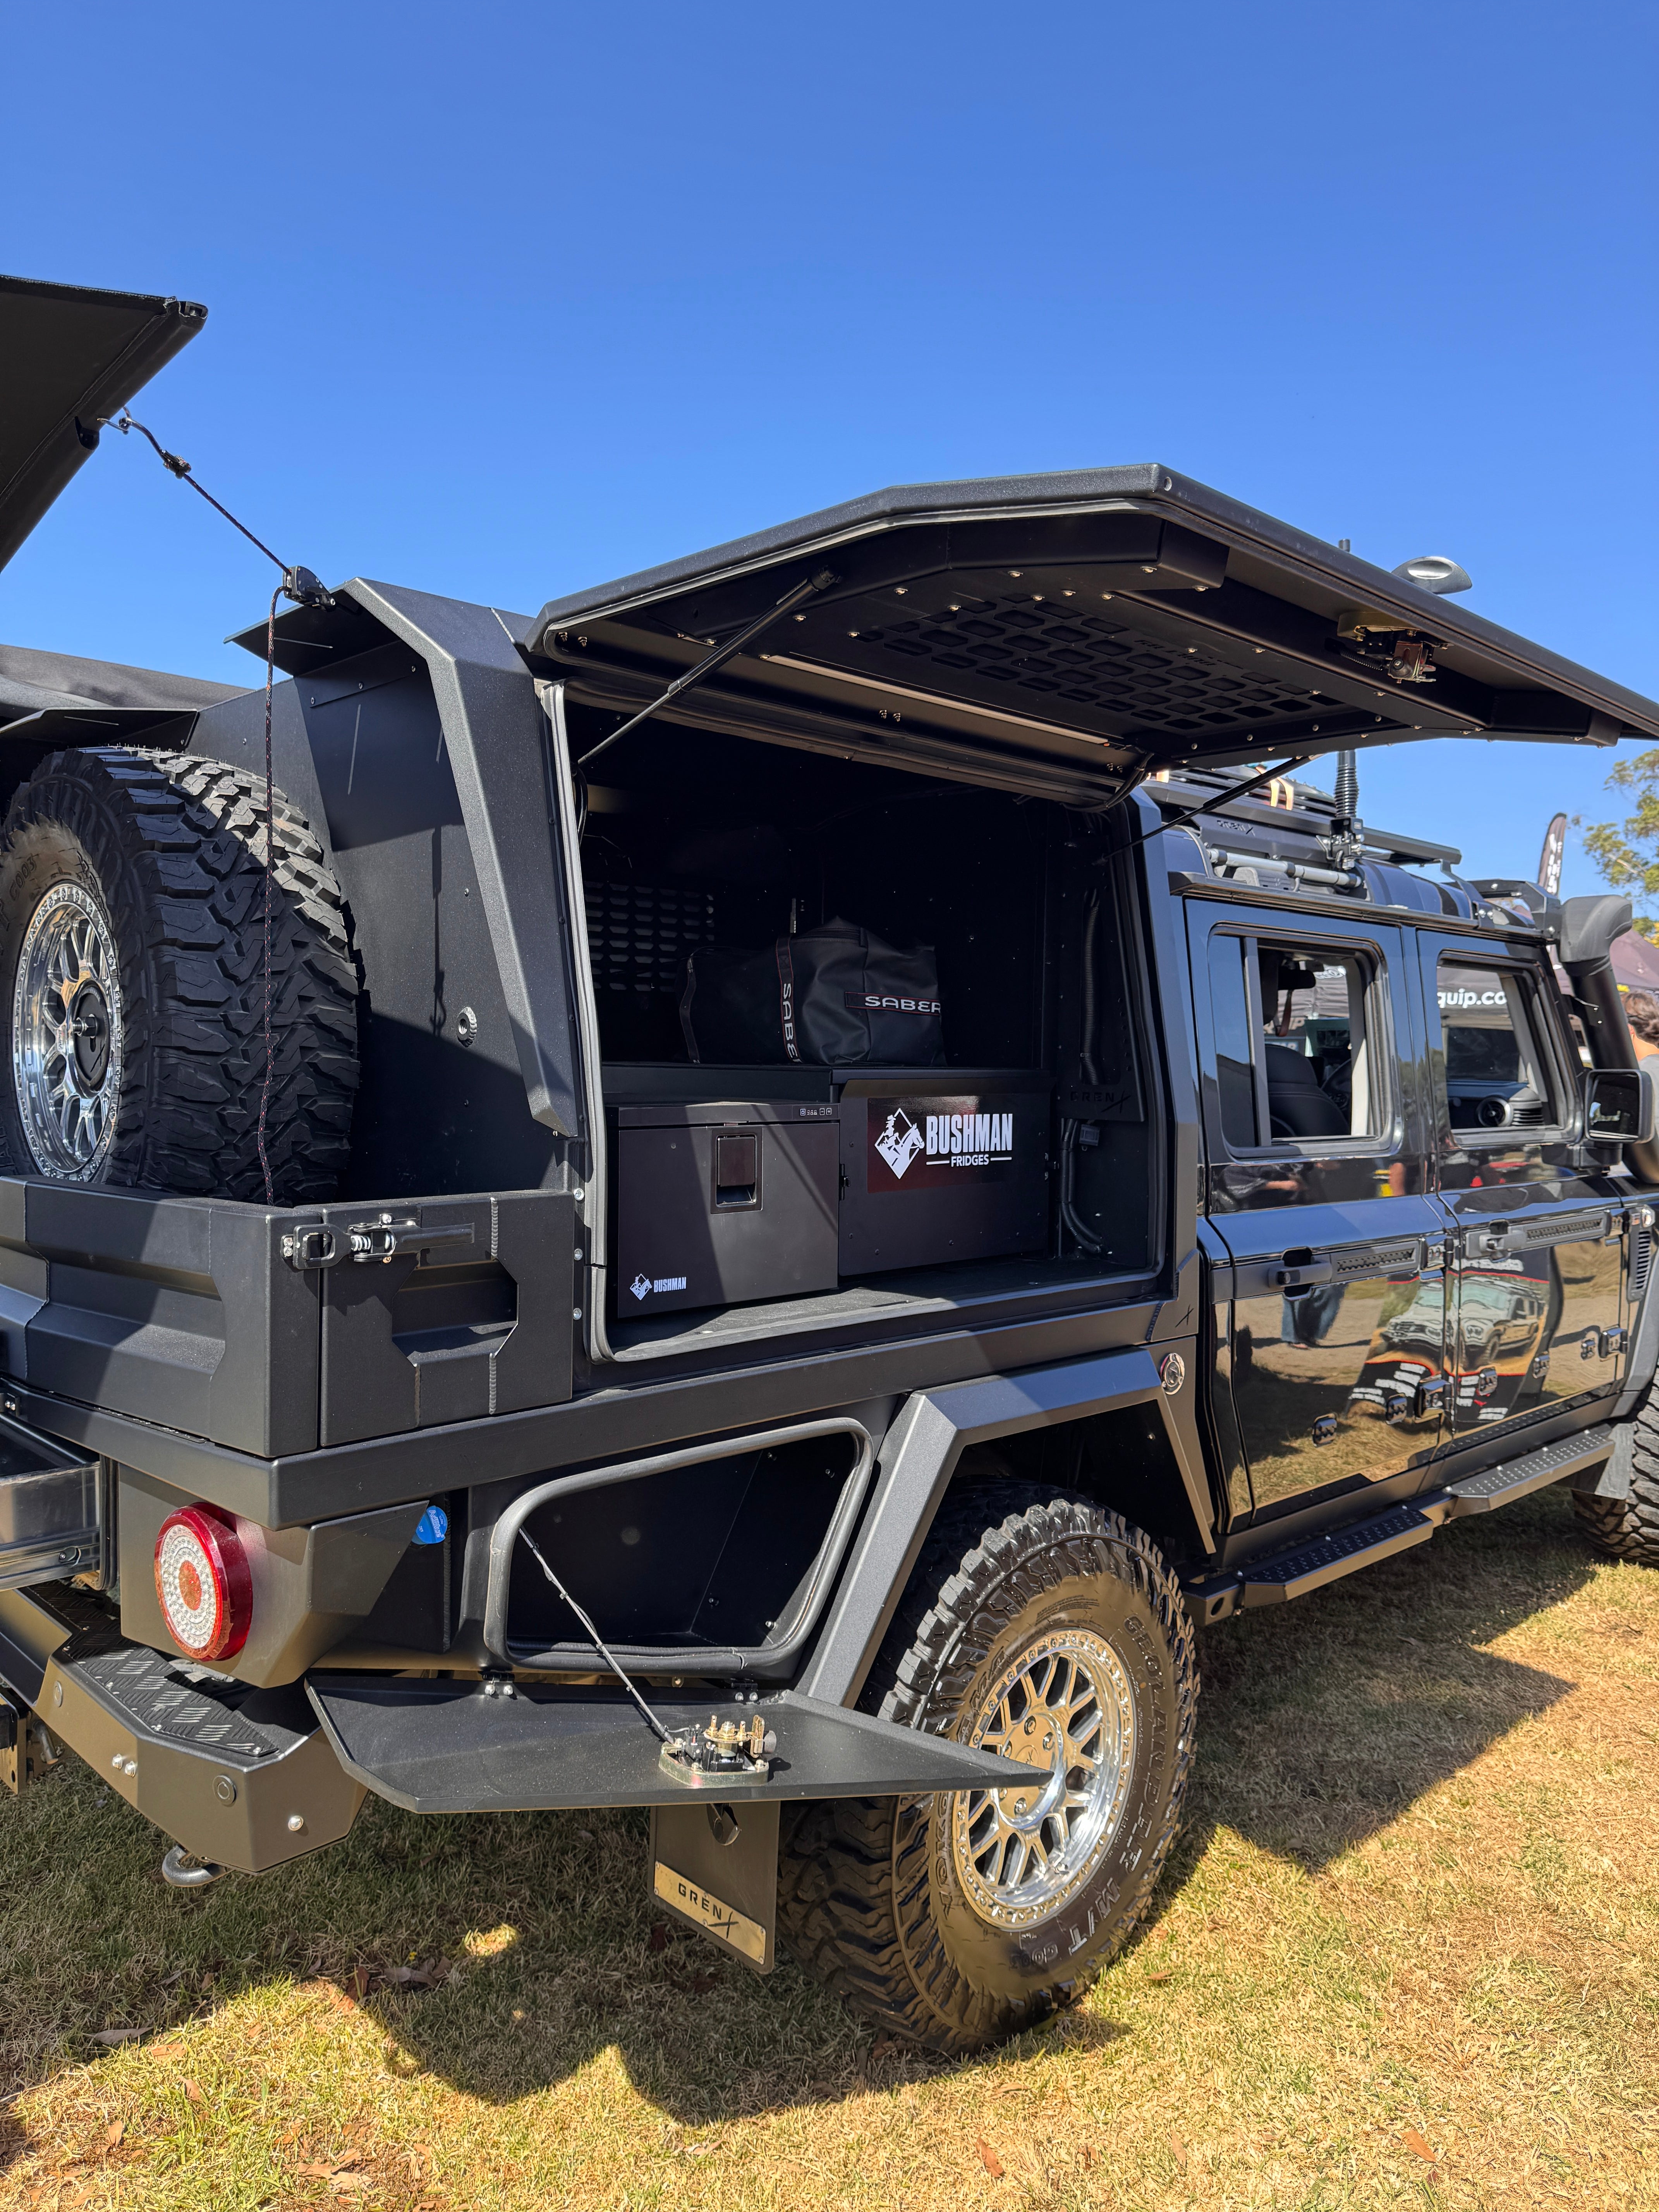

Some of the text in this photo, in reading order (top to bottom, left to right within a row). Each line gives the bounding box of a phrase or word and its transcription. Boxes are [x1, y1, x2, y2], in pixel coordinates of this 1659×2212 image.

[783, 983, 802, 1063] SABE
[926, 1113, 1013, 1155] BUSHMAN
[951, 1154, 989, 1167] FRIDGES
[654, 1277, 687, 1293] BUSHMAN
[1118, 1614, 1167, 1872] GEOLANDAR
[1068, 1877, 1120, 1956] M/T
